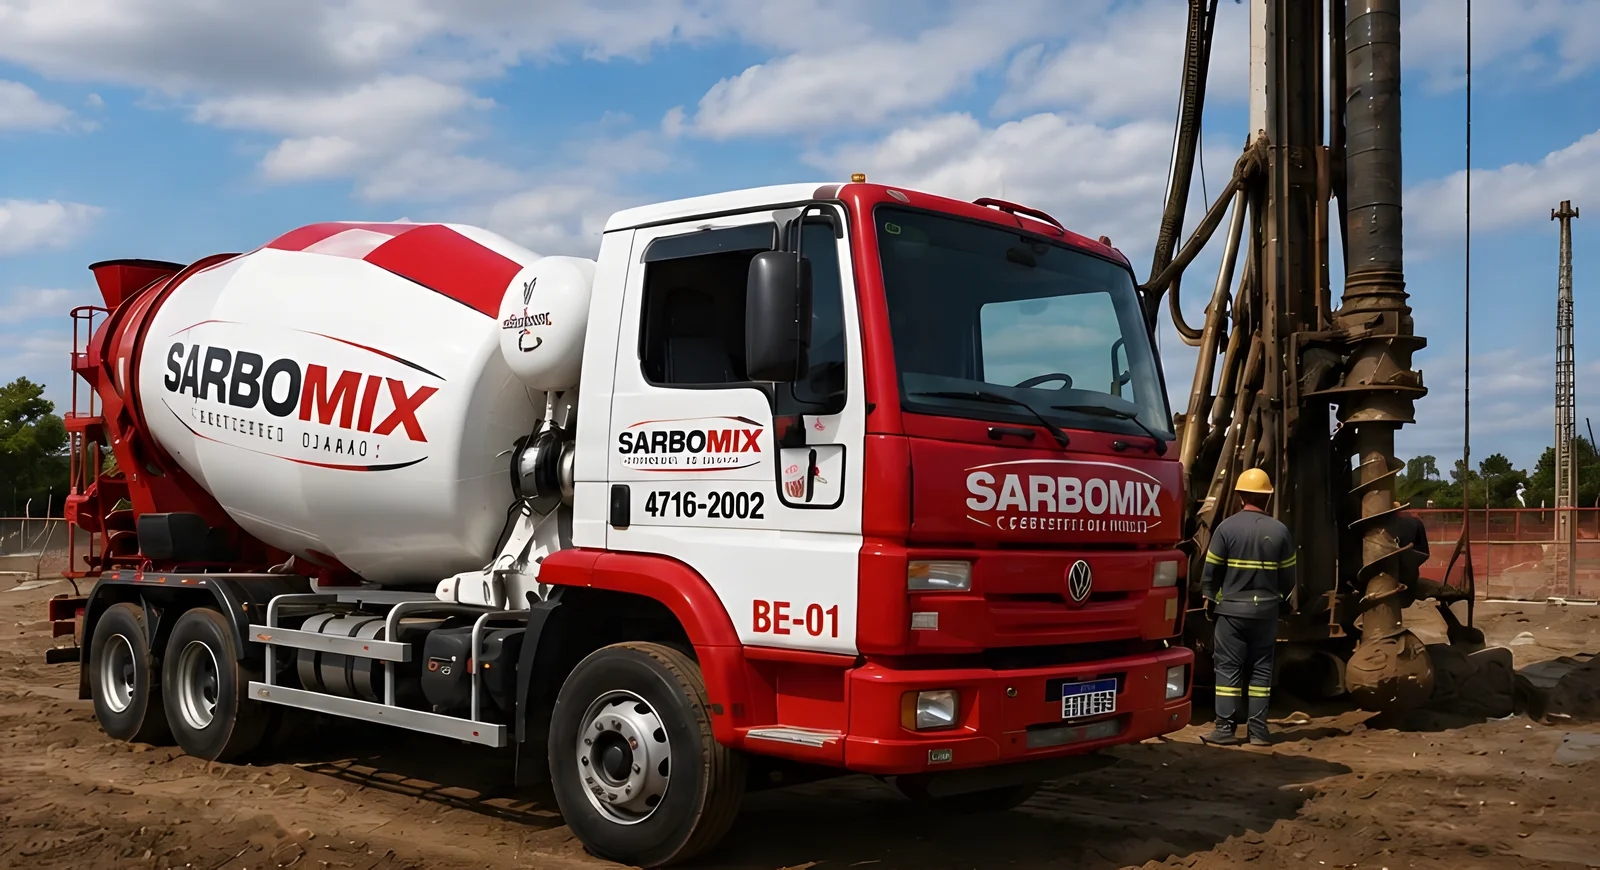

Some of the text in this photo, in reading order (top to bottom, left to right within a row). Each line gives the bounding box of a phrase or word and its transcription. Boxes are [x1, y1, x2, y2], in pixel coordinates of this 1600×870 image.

[164, 342, 440, 443] SARBOMIX
[618, 429, 764, 454] SARBOMIX
[645, 491, 764, 519] 4716-2002
[966, 471, 1161, 517] SARBOMIX
[753, 599, 838, 638] BE-01
